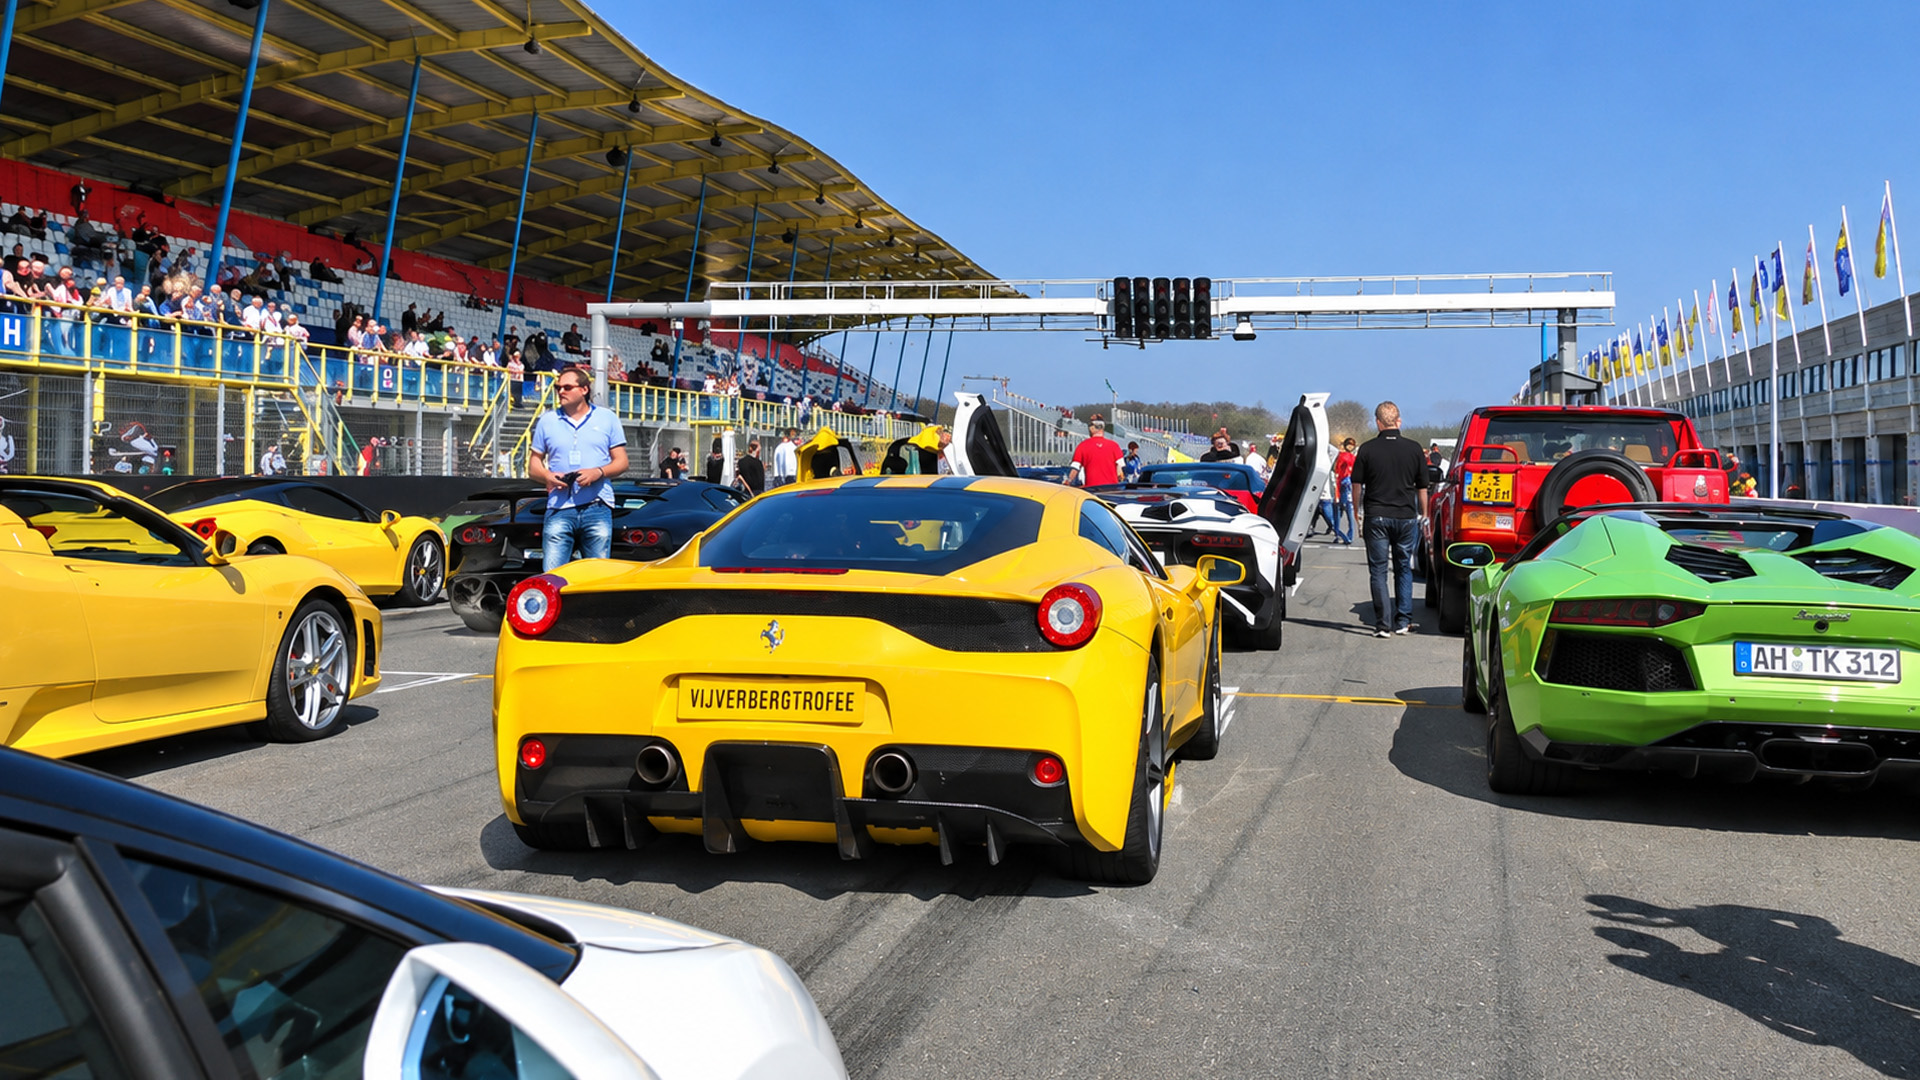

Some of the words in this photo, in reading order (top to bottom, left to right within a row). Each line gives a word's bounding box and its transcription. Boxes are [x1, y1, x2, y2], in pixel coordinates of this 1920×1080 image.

[4, 317, 21, 346] H
[1754, 647, 1787, 671] AH
[1806, 649, 1841, 674] TK
[1846, 651, 1895, 677] 312
[691, 689, 855, 712] VIJVERBERGTROFEE
